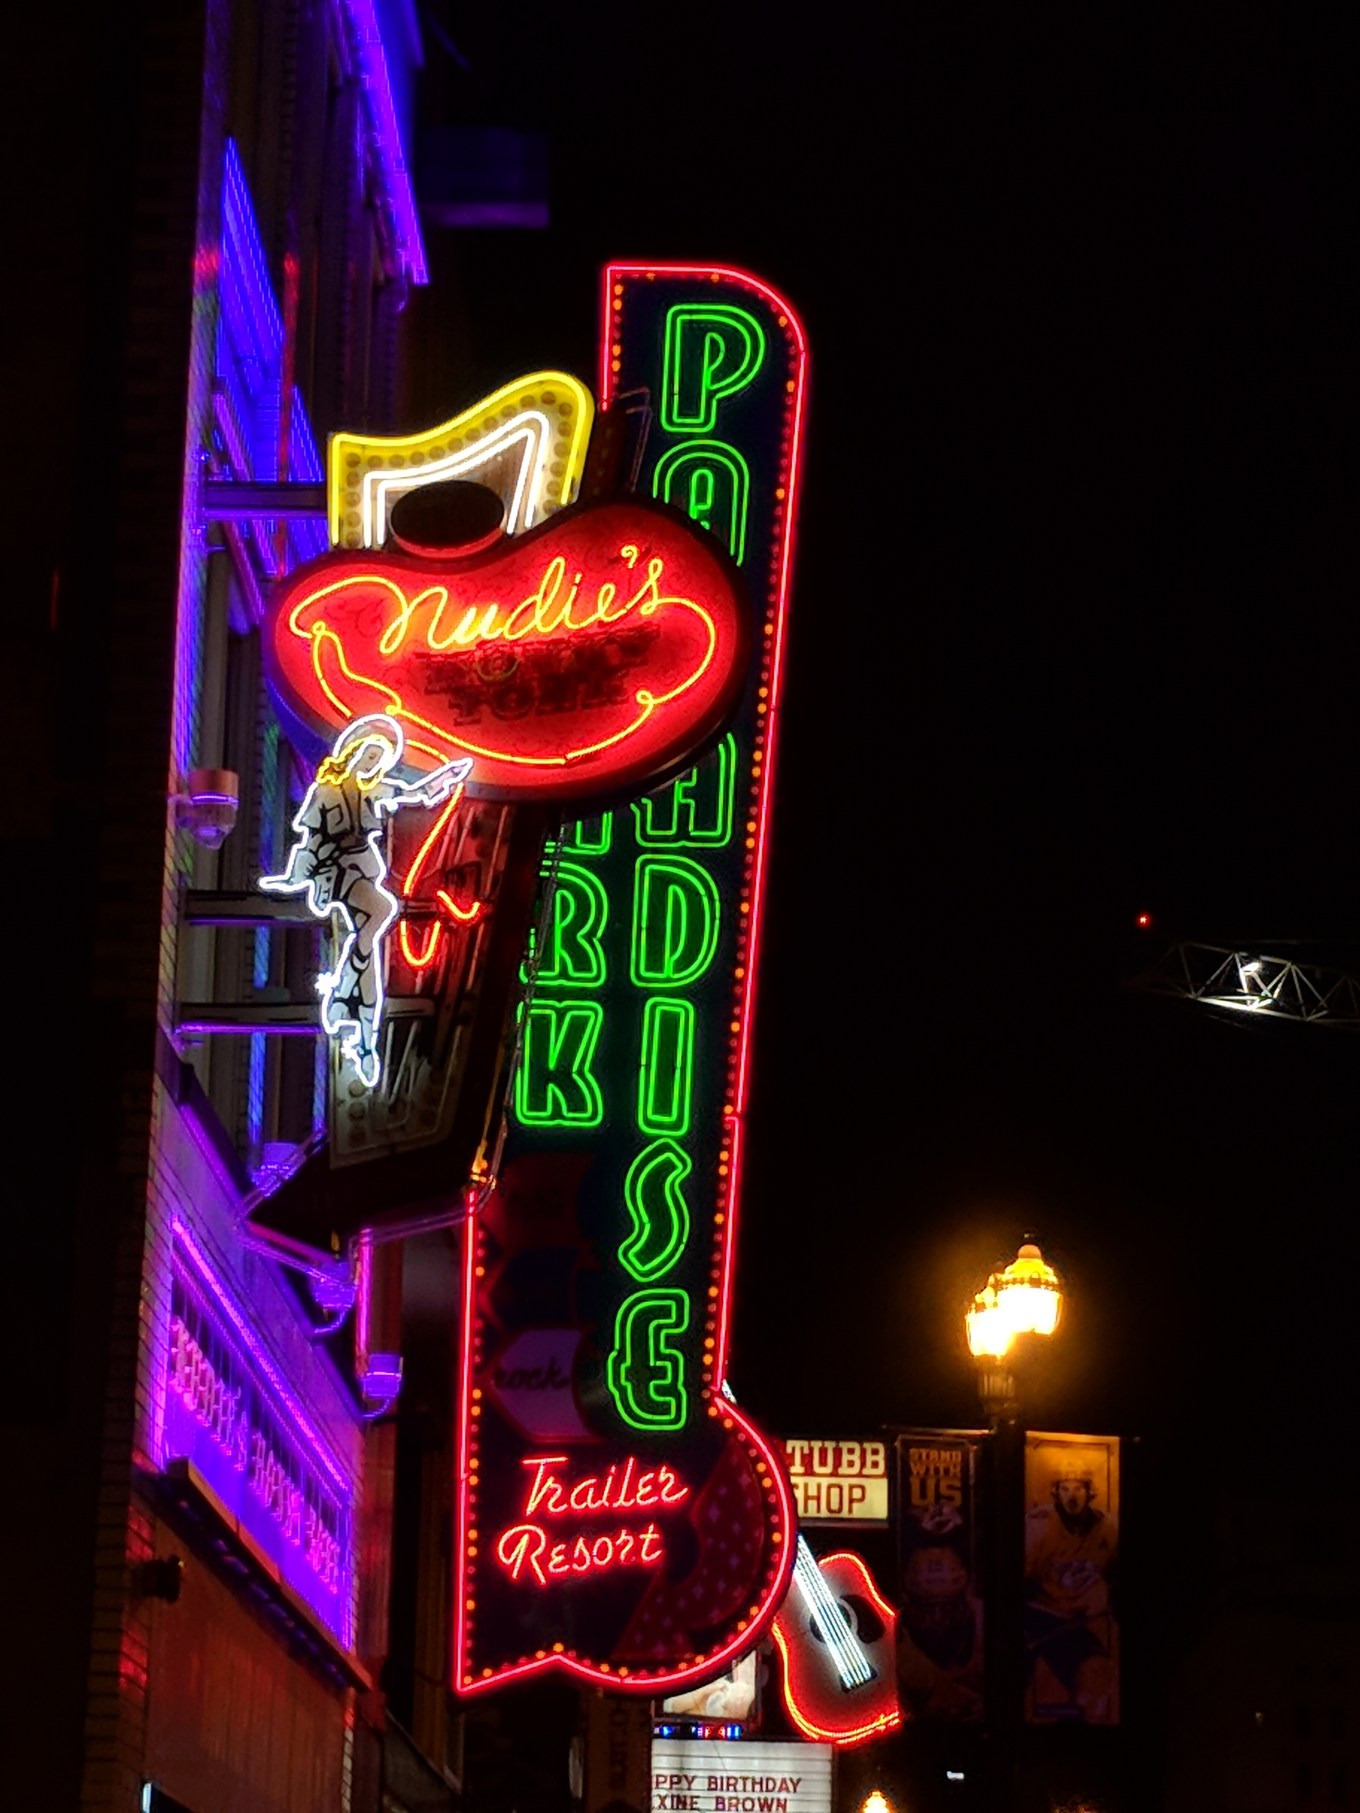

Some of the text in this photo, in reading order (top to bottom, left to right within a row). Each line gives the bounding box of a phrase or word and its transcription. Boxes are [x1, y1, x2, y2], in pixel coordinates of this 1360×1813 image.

[605, 303, 768, 1434] PAADISE
[786, 1440, 885, 1475] TUBB
[910, 1462, 961, 1476] WITH
[522, 1456, 688, 1516] Trailer
[910, 1476, 961, 1508] US
[496, 1523, 663, 1585] Resort
[708, 1775, 802, 1793] BIRTHDAY
[715, 1796, 788, 1812] BROWN
